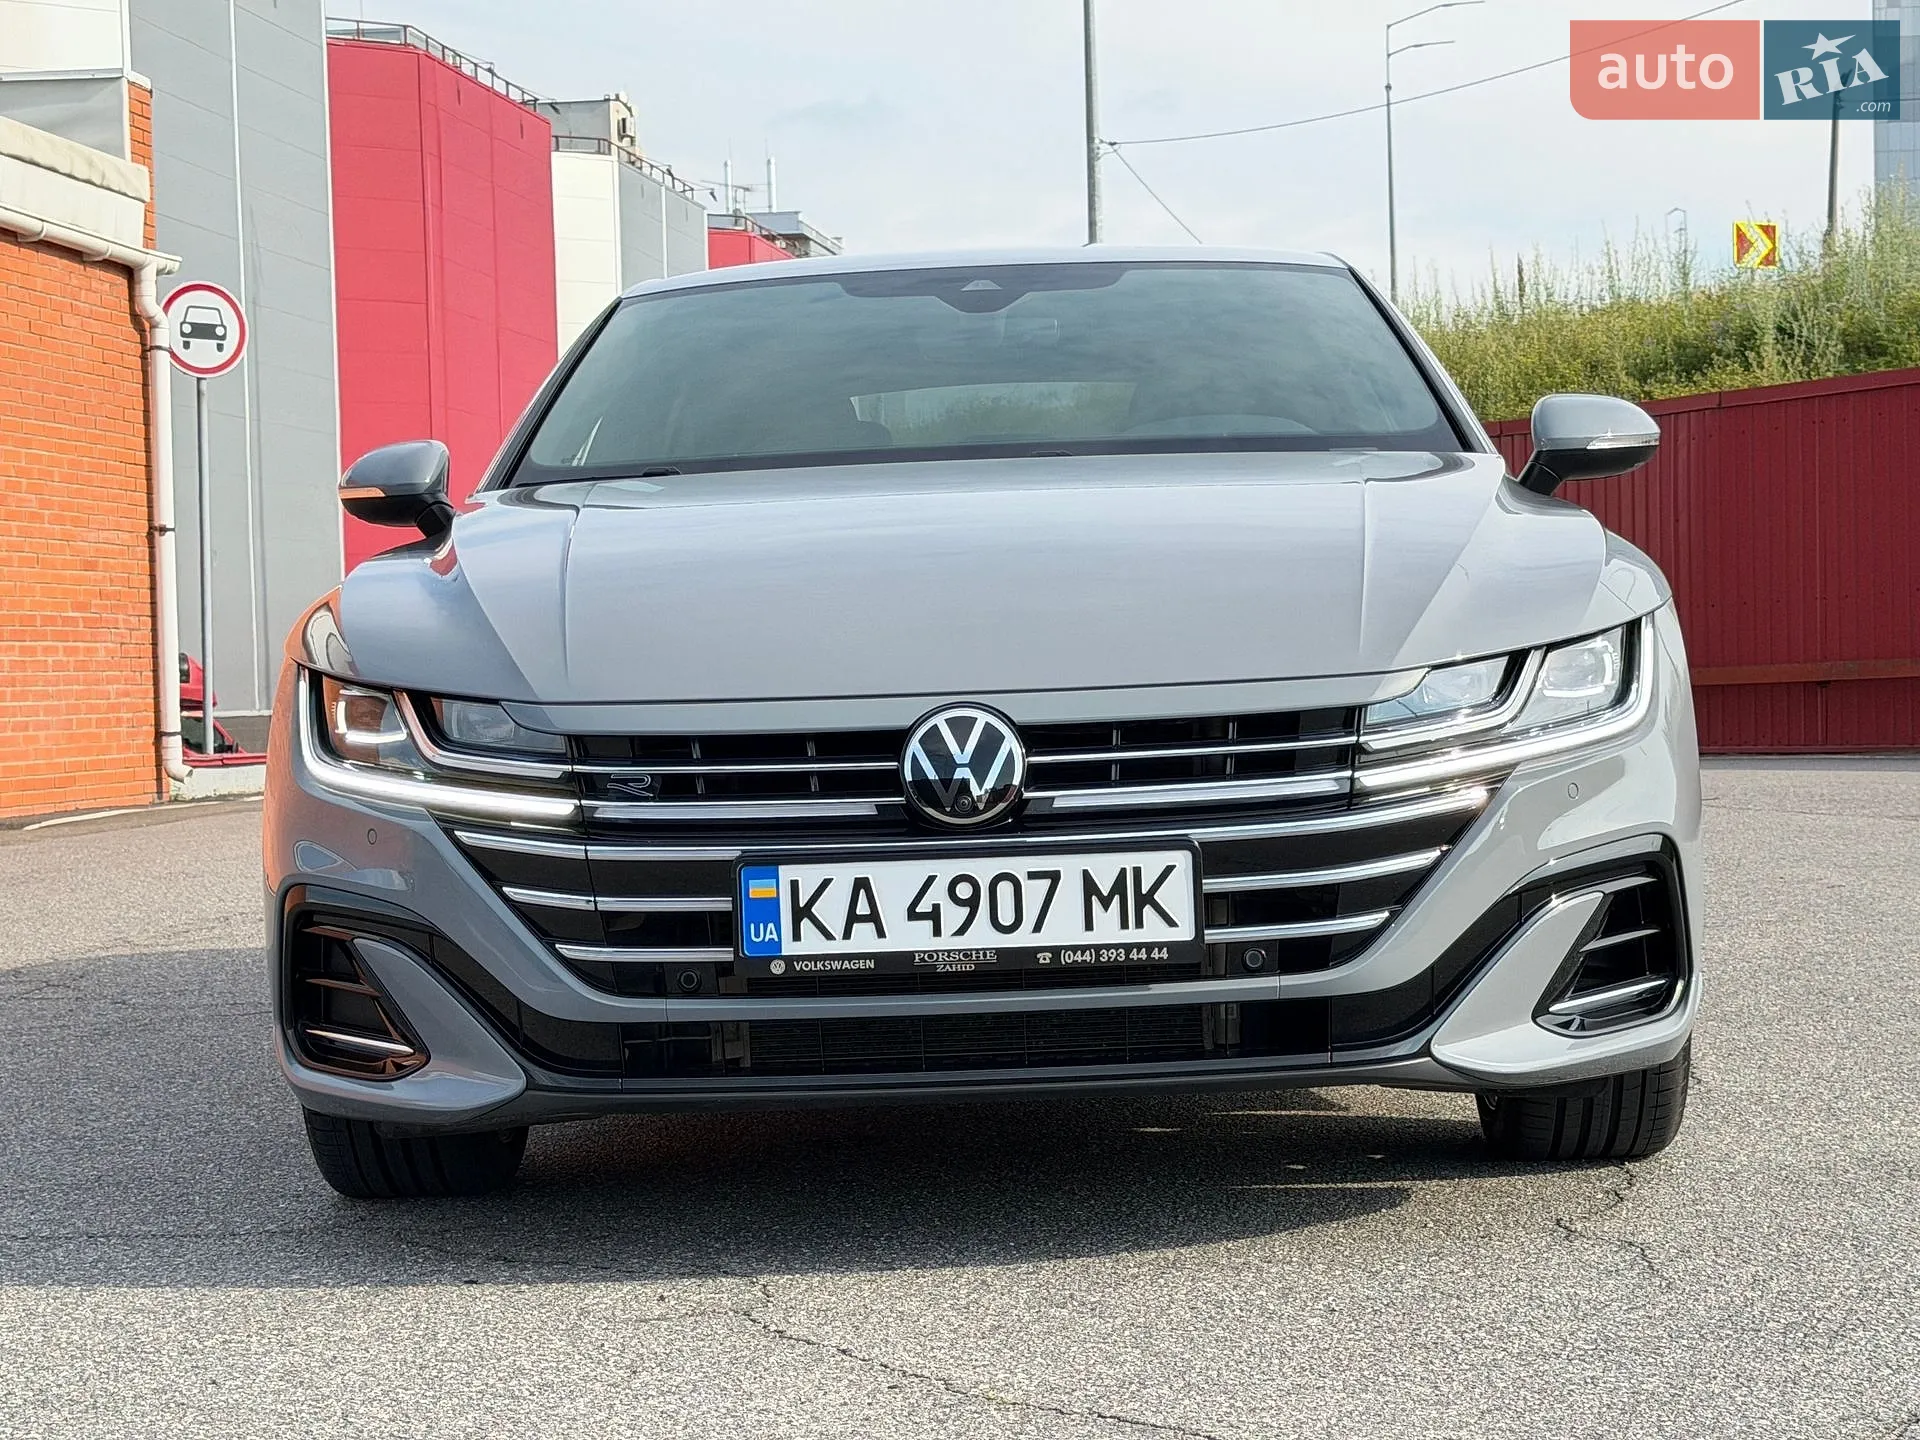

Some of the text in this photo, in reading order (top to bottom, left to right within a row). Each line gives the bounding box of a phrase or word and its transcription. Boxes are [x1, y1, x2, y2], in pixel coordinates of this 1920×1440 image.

[789, 863, 1180, 943] KA 4907 MK
[749, 922, 780, 943] UA
[913, 949, 998, 963] PORSCHE
[1060, 947, 1169, 965] (044) 393 44 44
[793, 959, 875, 971] VOLKSWAGEN
[936, 963, 976, 972] ZAHID
